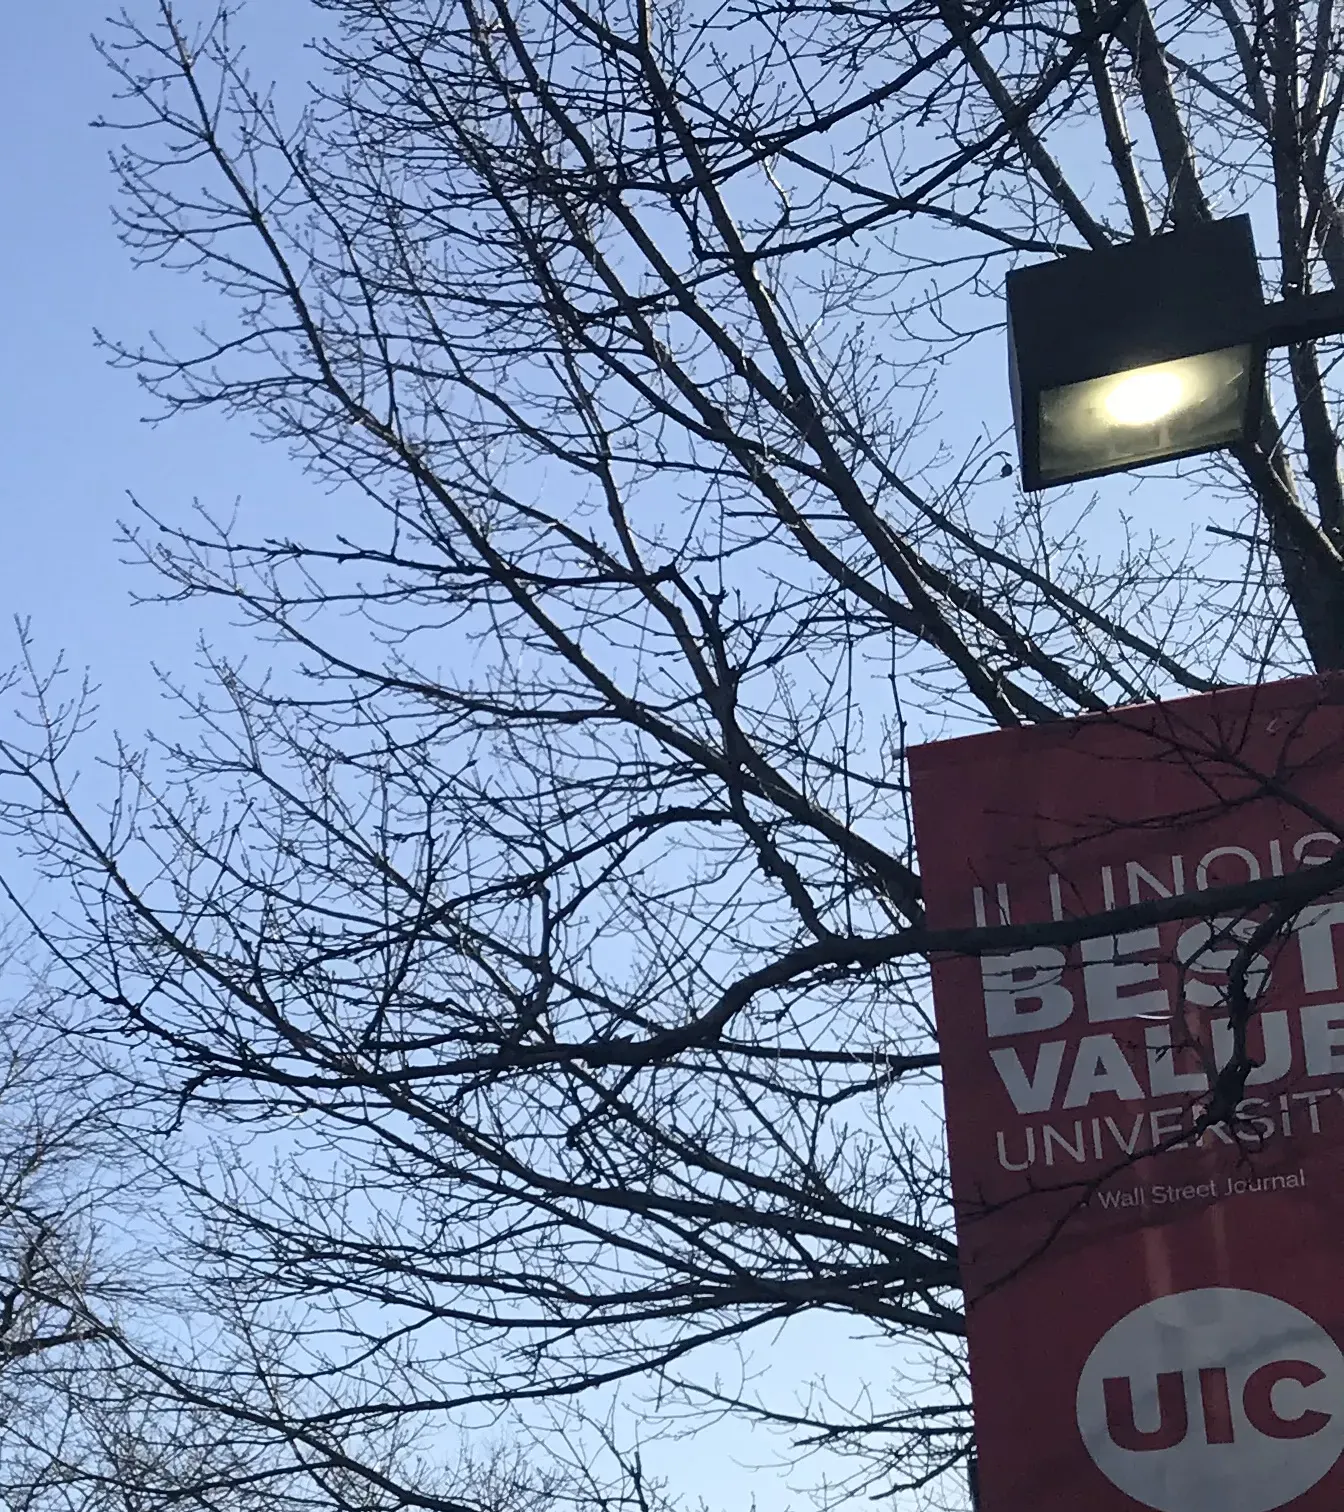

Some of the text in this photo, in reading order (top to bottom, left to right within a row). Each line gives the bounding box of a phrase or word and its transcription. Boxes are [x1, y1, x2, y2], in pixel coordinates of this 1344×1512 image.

[981, 901, 1344, 1038] BEST
[989, 1003, 1344, 1115] VALUE
[1098, 1168, 1306, 1210] Wall Street Journal
[1102, 1359, 1333, 1453] UIC
